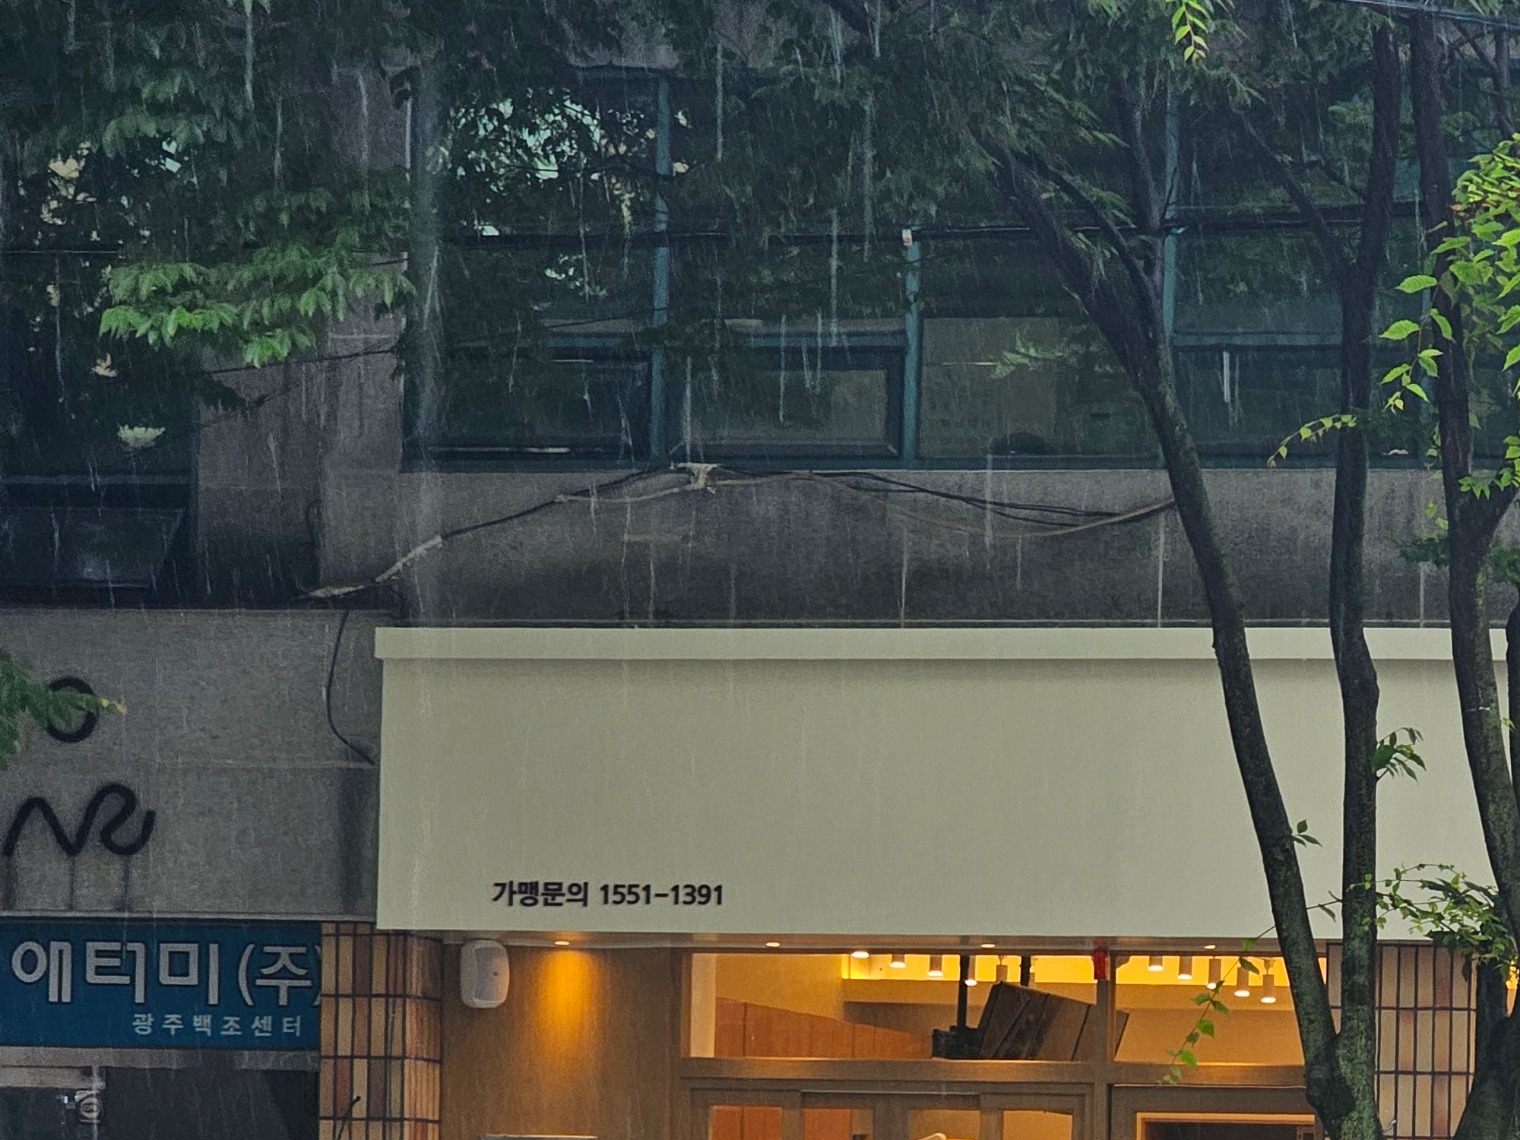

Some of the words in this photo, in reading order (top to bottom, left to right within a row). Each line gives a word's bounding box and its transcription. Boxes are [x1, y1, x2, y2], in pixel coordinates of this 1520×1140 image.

[492, 880, 590, 908] 가맹문의
[600, 884, 725, 907] 1551-1391
[132, 1013, 302, 1038] 광주백조센터
